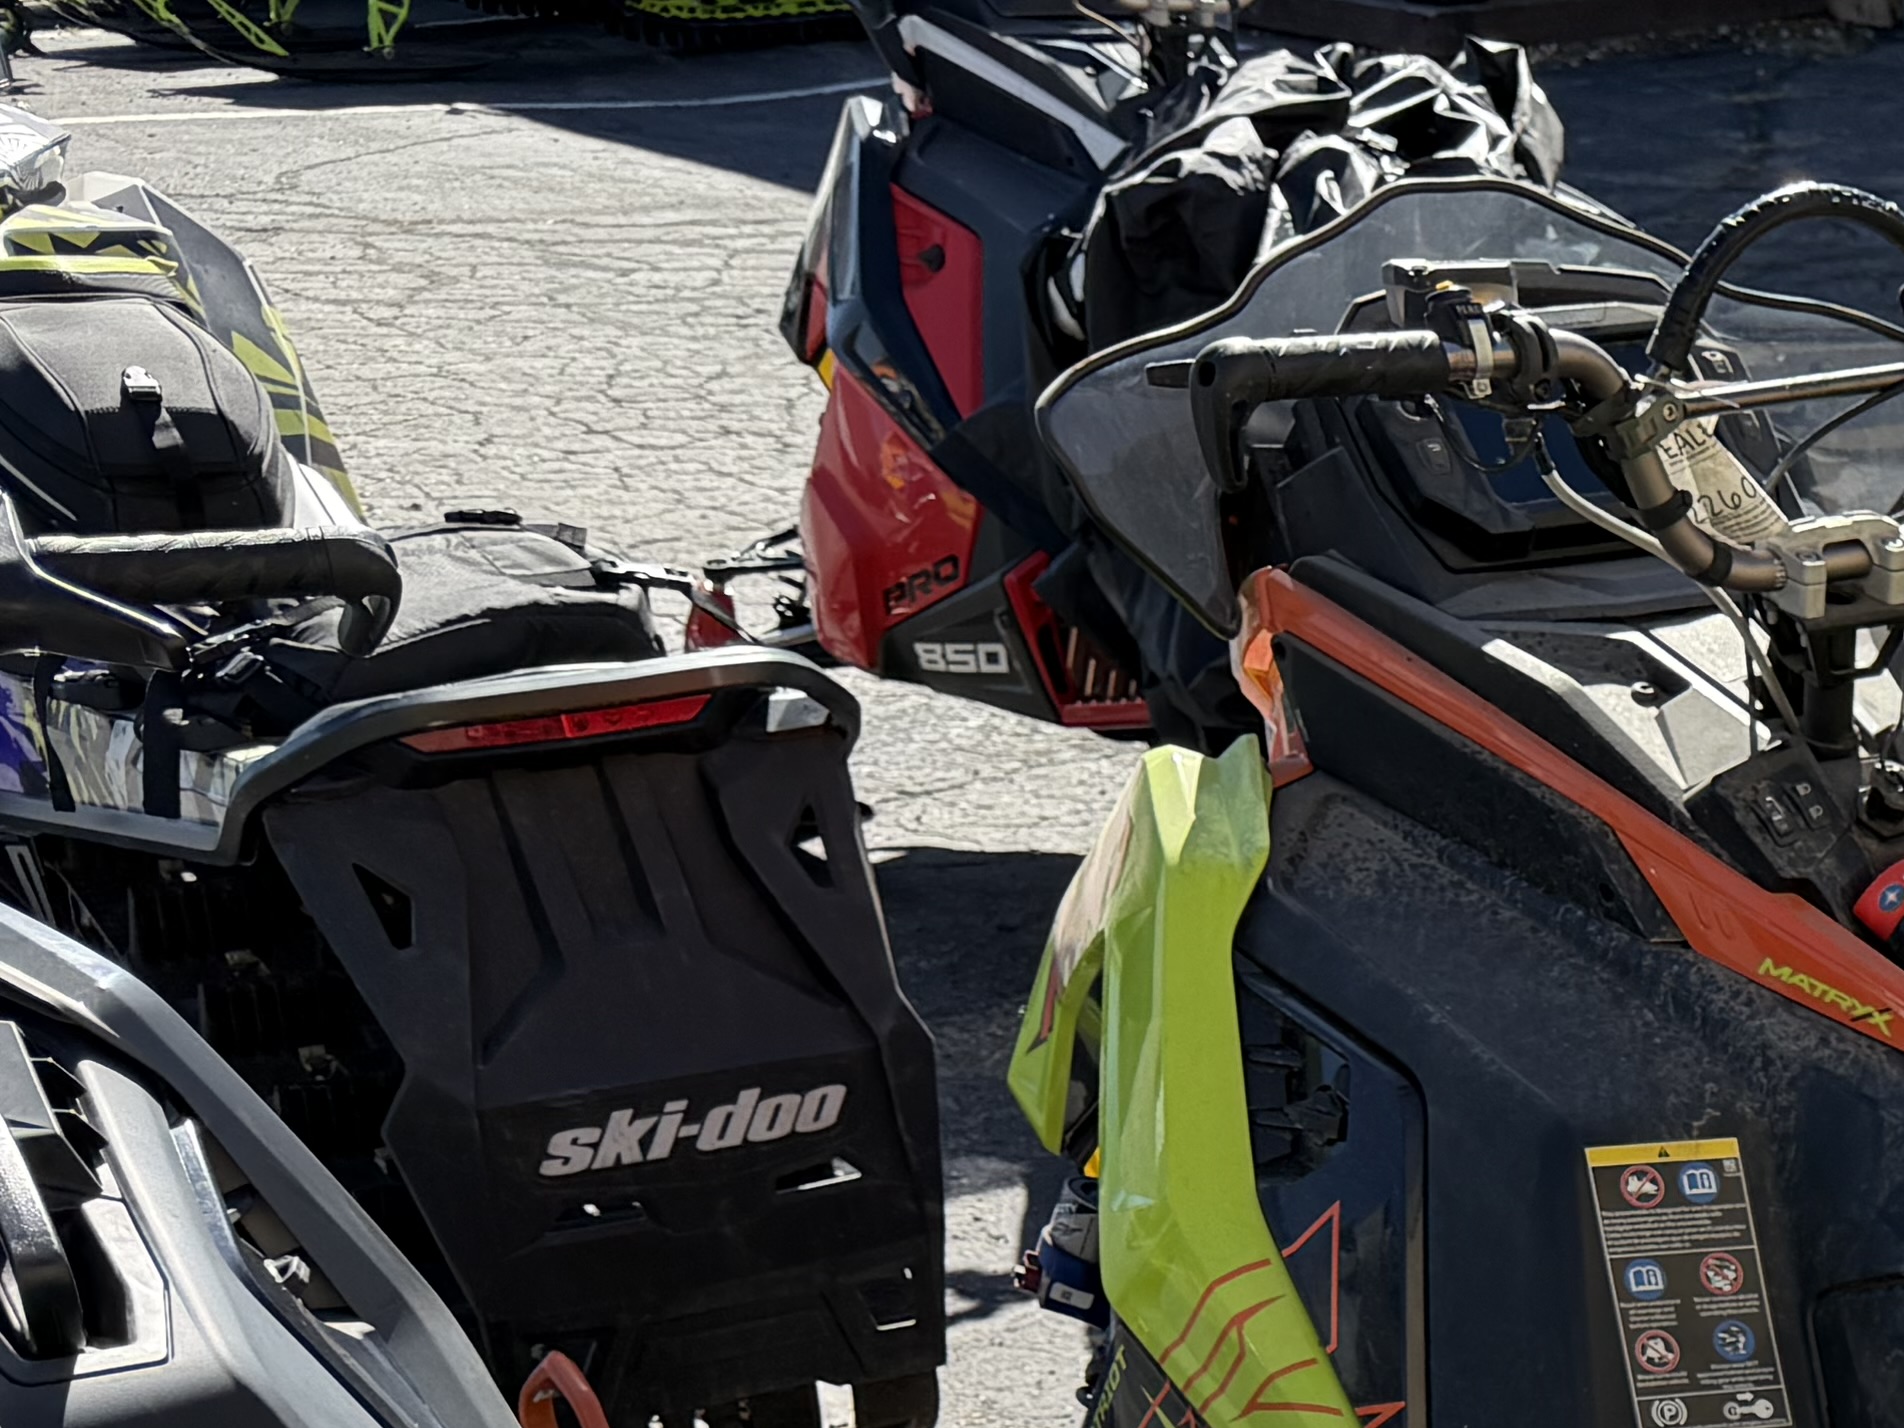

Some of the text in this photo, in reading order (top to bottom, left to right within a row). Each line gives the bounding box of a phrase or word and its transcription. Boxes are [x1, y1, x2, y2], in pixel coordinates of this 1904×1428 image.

[883, 554, 959, 615] PRO
[913, 642, 1009, 674] 850
[1758, 957, 1893, 1037] MATRYX
[538, 1083, 848, 1178] ski-doo
